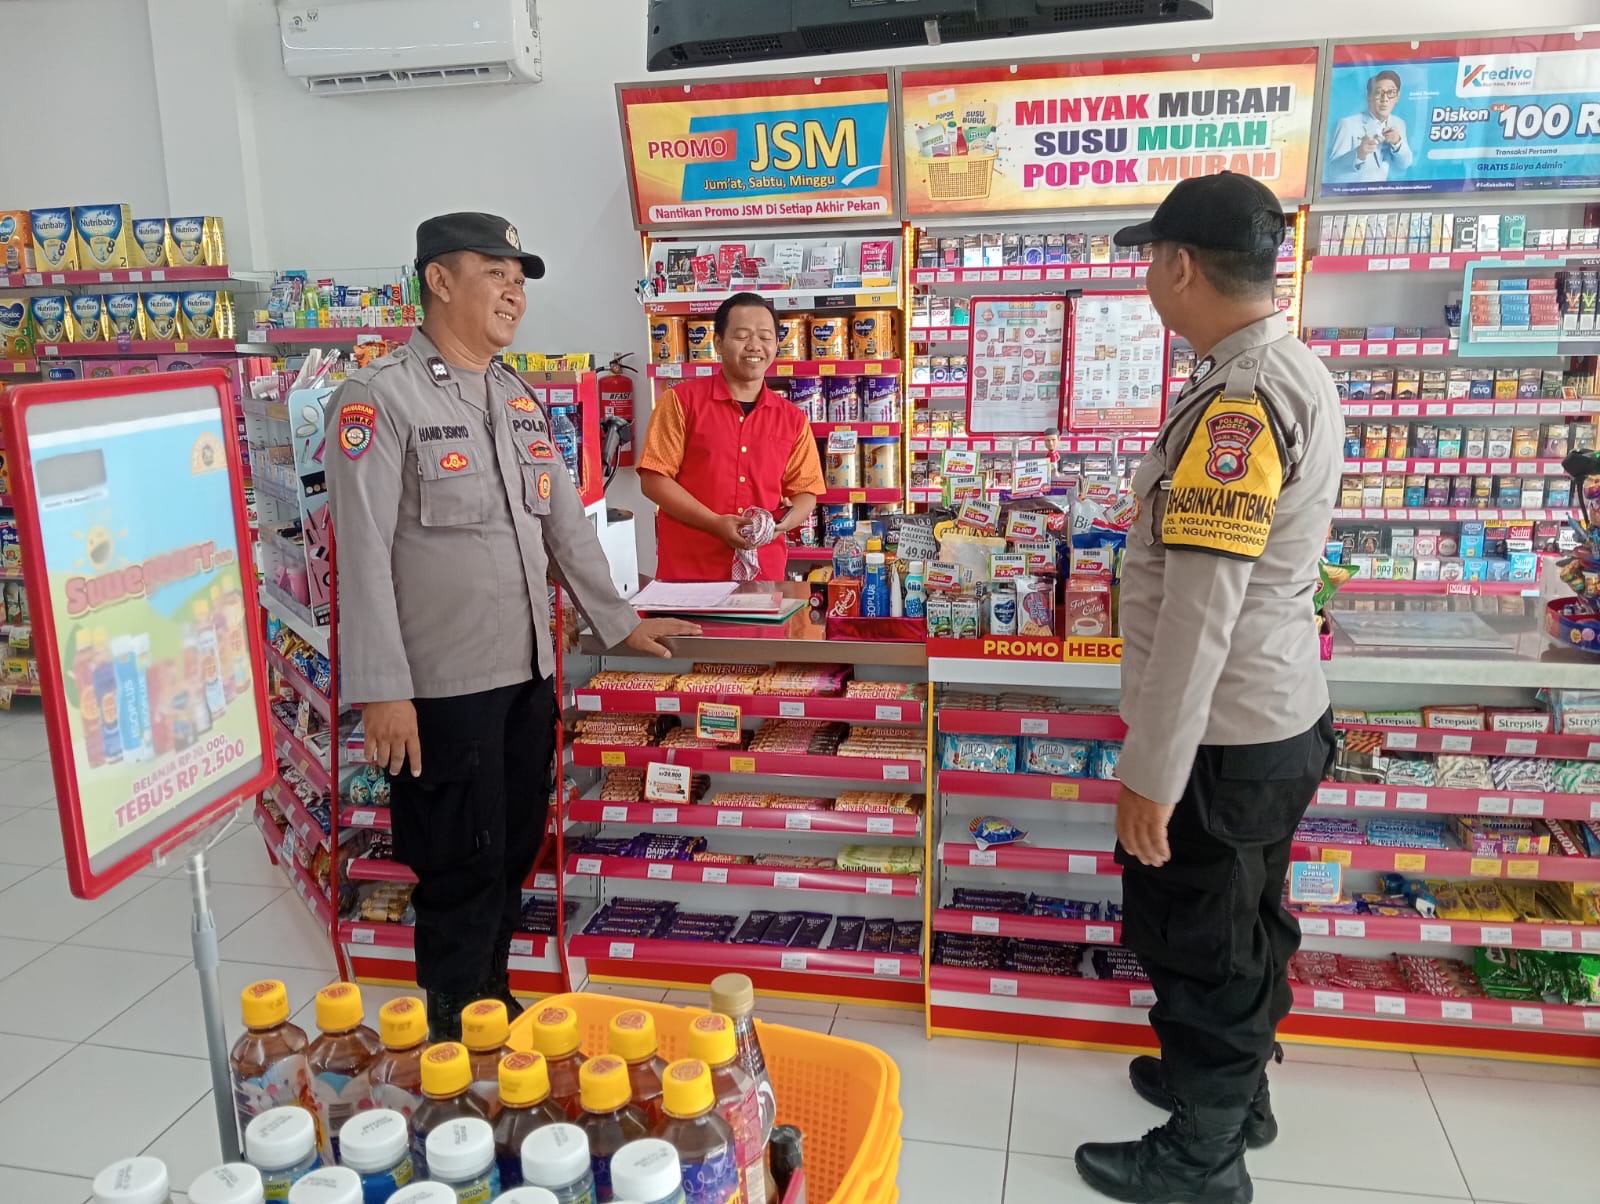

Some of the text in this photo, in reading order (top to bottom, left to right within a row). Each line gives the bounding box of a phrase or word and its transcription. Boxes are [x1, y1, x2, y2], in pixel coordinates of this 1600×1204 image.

[1463, 64, 1533, 87] Kredivo
[1015, 85, 1291, 126] MINYAK MURAH
[1432, 106, 1489, 123] Diskon
[1499, 104, 1571, 138] 100
[1034, 120, 1268, 157] SUSU MURAH
[1429, 124, 1466, 141] 50%
[647, 137, 728, 160] PROMO
[749, 117, 860, 172] JSM
[1023, 153, 1276, 188] POPOK MURAH
[1477, 162, 1509, 171] GRATIS
[1510, 161, 1535, 171] Biaya
[748, 175, 787, 190] Sabtu,
[789, 173, 836, 188] Minggu
[655, 198, 881, 220] Nantikan Promo JSM Di Setiap Akhir Pekan
[80, 218, 117, 228] Nutribaby
[1215, 423, 1252, 433] MAGETAN
[1218, 418, 1249, 427] POLRES
[983, 639, 1059, 657] PROMO
[599, 678, 654, 690] SILVERQUEEN
[686, 680, 744, 694] SILVERQUEEN
[1433, 716, 1478, 726] Strepsils
[1498, 718, 1544, 728] Strepsils
[114, 737, 245, 828] TEBUS RP 2.500
[132, 762, 177, 795] BELANJA
[840, 803, 889, 814] SILVERQUEEN
